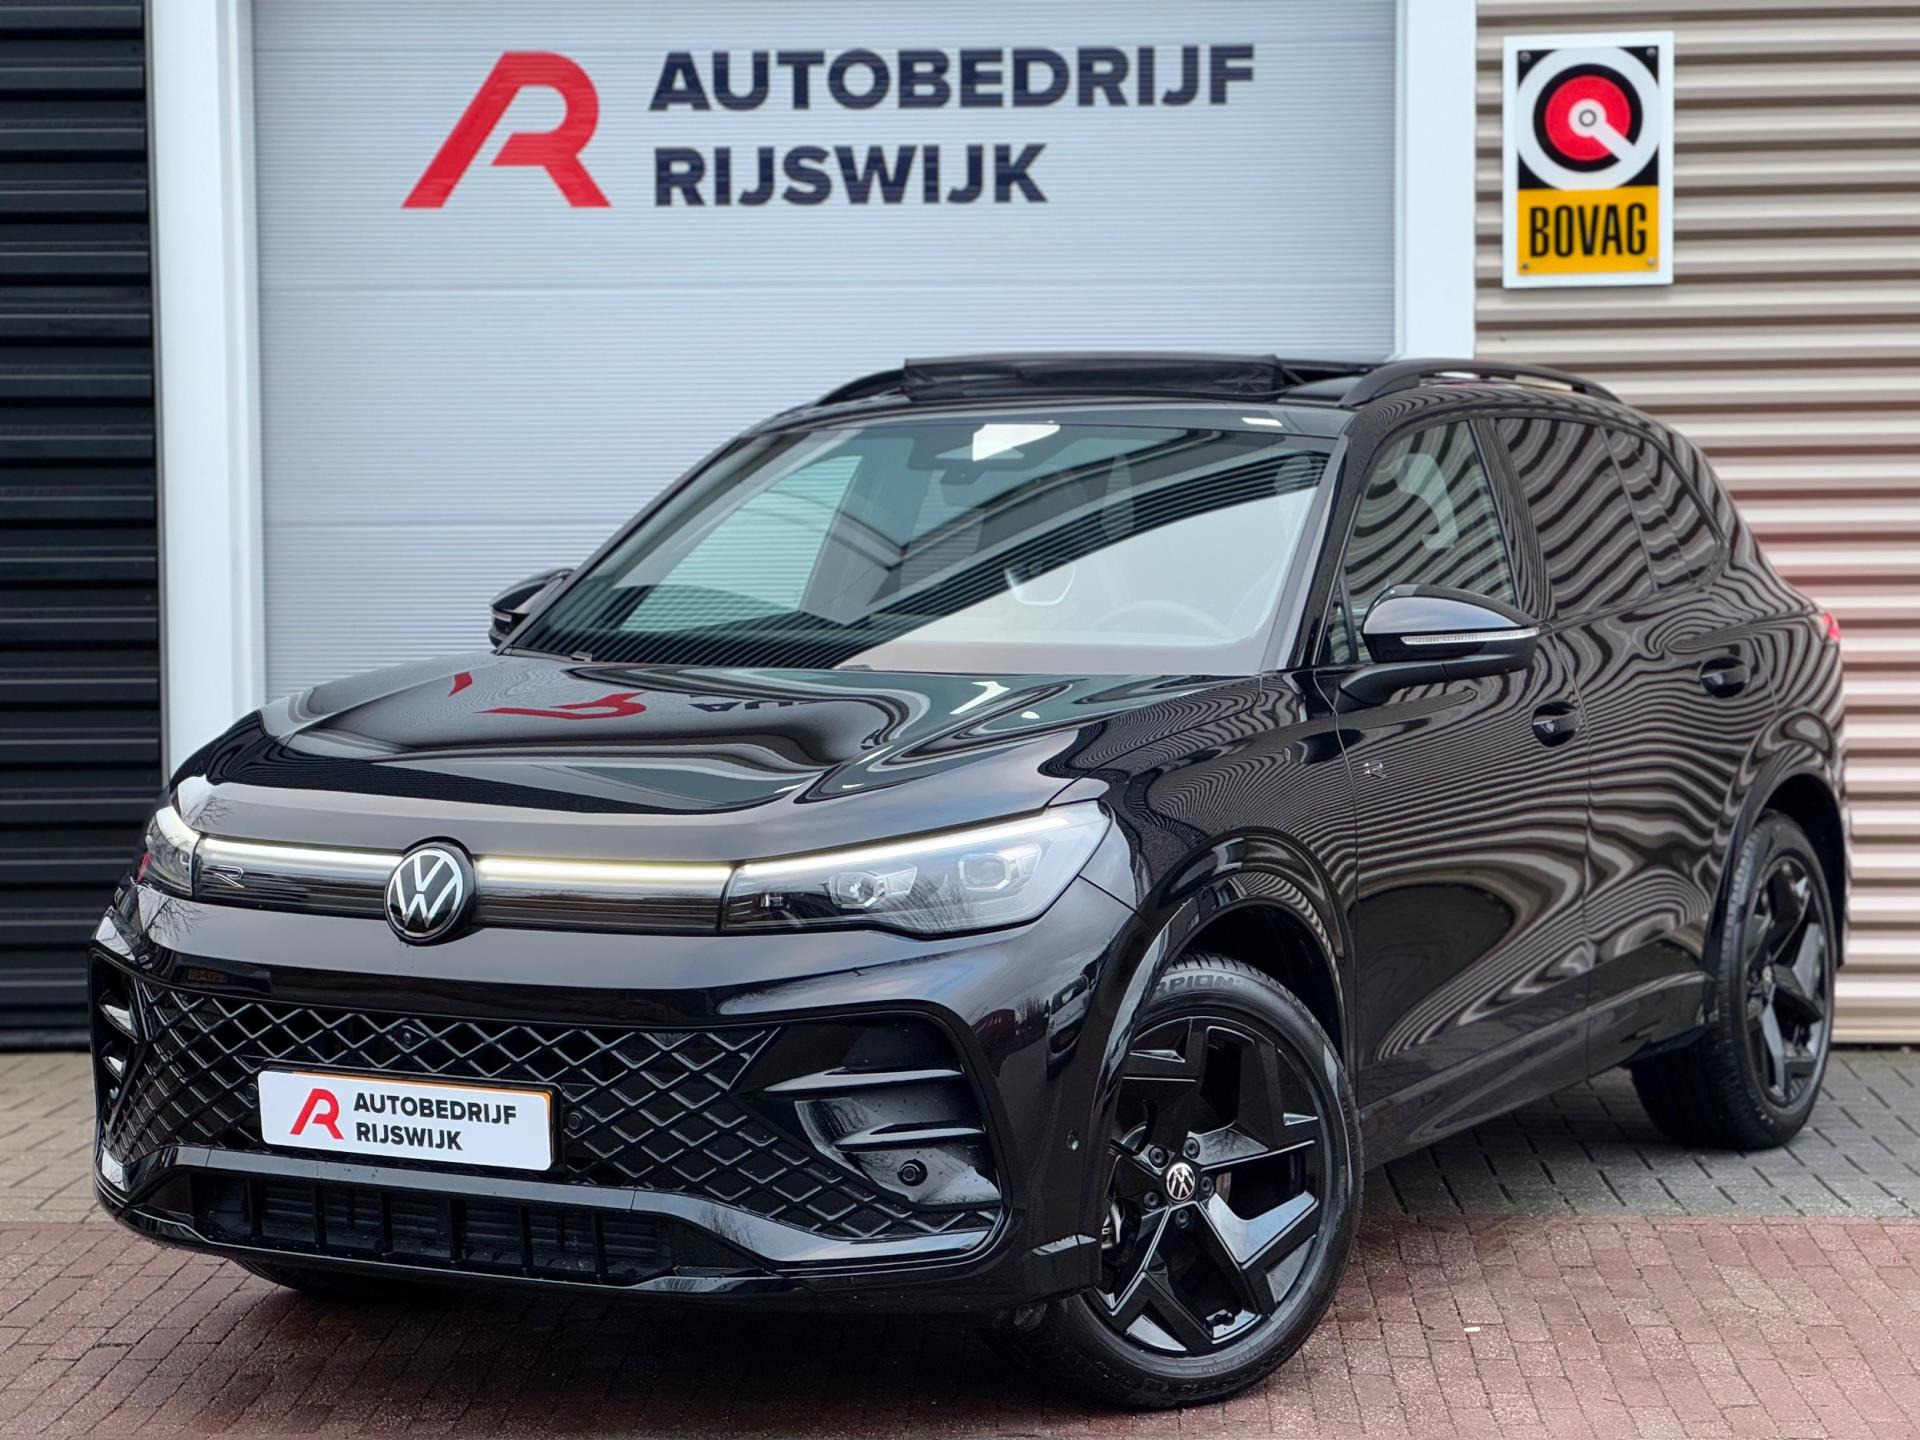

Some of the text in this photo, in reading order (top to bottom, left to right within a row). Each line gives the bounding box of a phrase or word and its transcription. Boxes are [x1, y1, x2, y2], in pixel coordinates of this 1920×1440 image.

[649, 45, 1255, 111] AUTOBEDRIJF
[653, 143, 1048, 207] RIJSWIJK
[1529, 202, 1648, 257] BOVAG
[353, 1092, 517, 1125] AUTOBEDRIJF
[356, 1122, 463, 1151] RIJSWIJK
